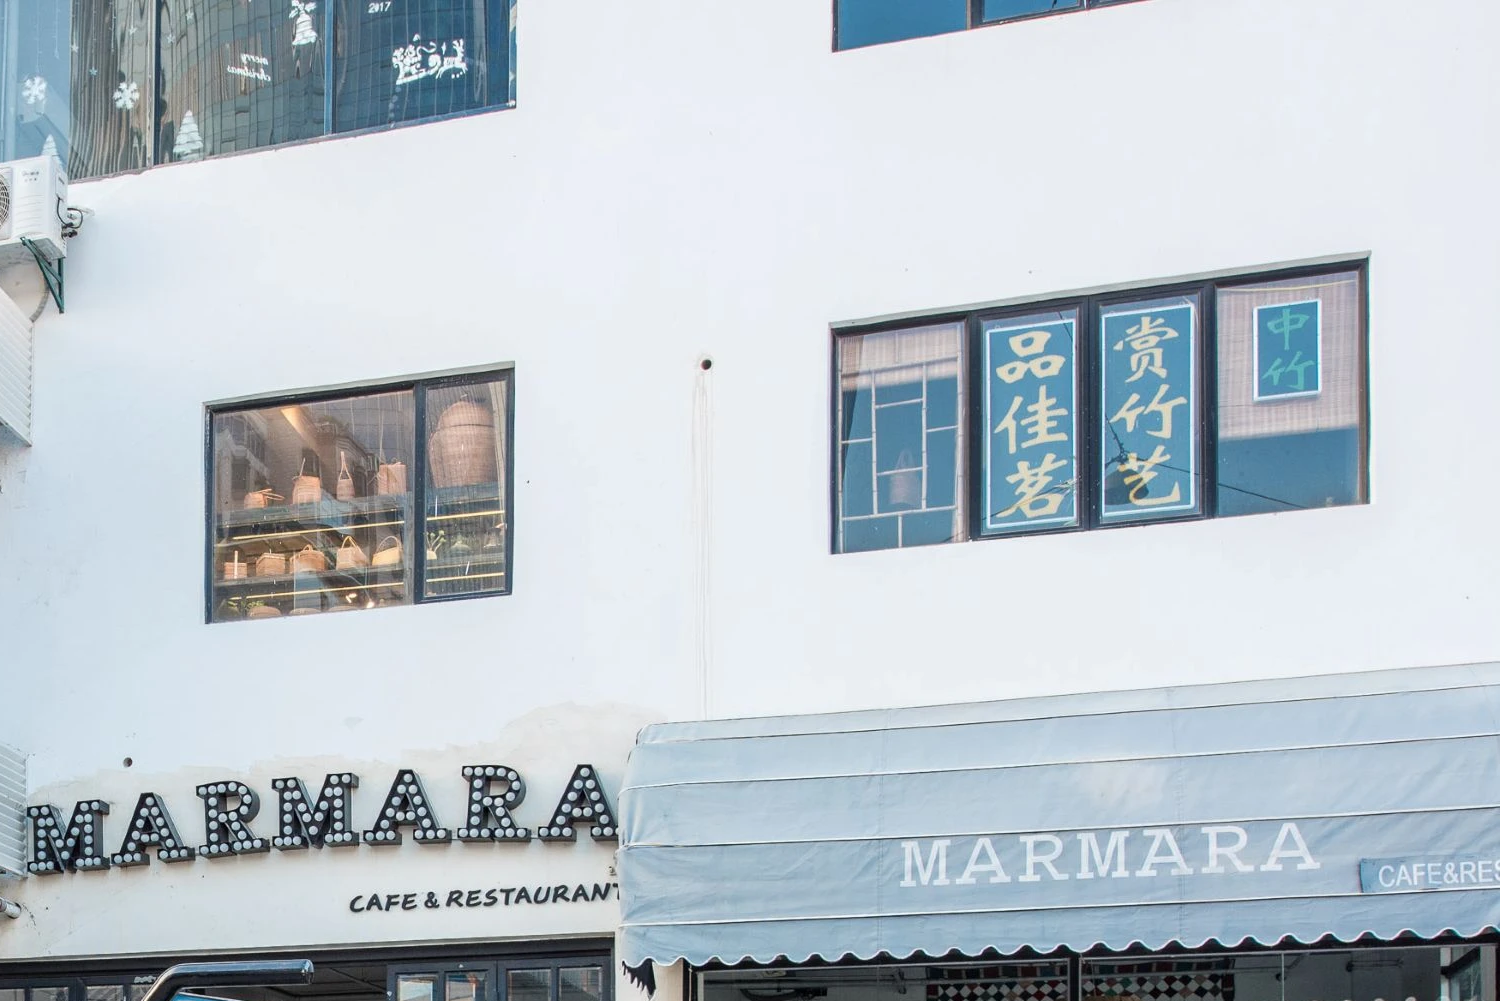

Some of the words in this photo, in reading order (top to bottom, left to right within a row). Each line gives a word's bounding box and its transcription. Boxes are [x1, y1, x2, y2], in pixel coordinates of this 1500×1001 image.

[368, 1, 392, 13] 2017
[1261, 309, 1314, 390] 中竹
[993, 330, 1069, 519] 品佳茗
[1111, 316, 1188, 506] 赏竹艺
[27, 763, 618, 876] MARMARA
[900, 822, 1320, 887] MARMARA
[349, 893, 418, 912] CAFE
[423, 891, 440, 909] &
